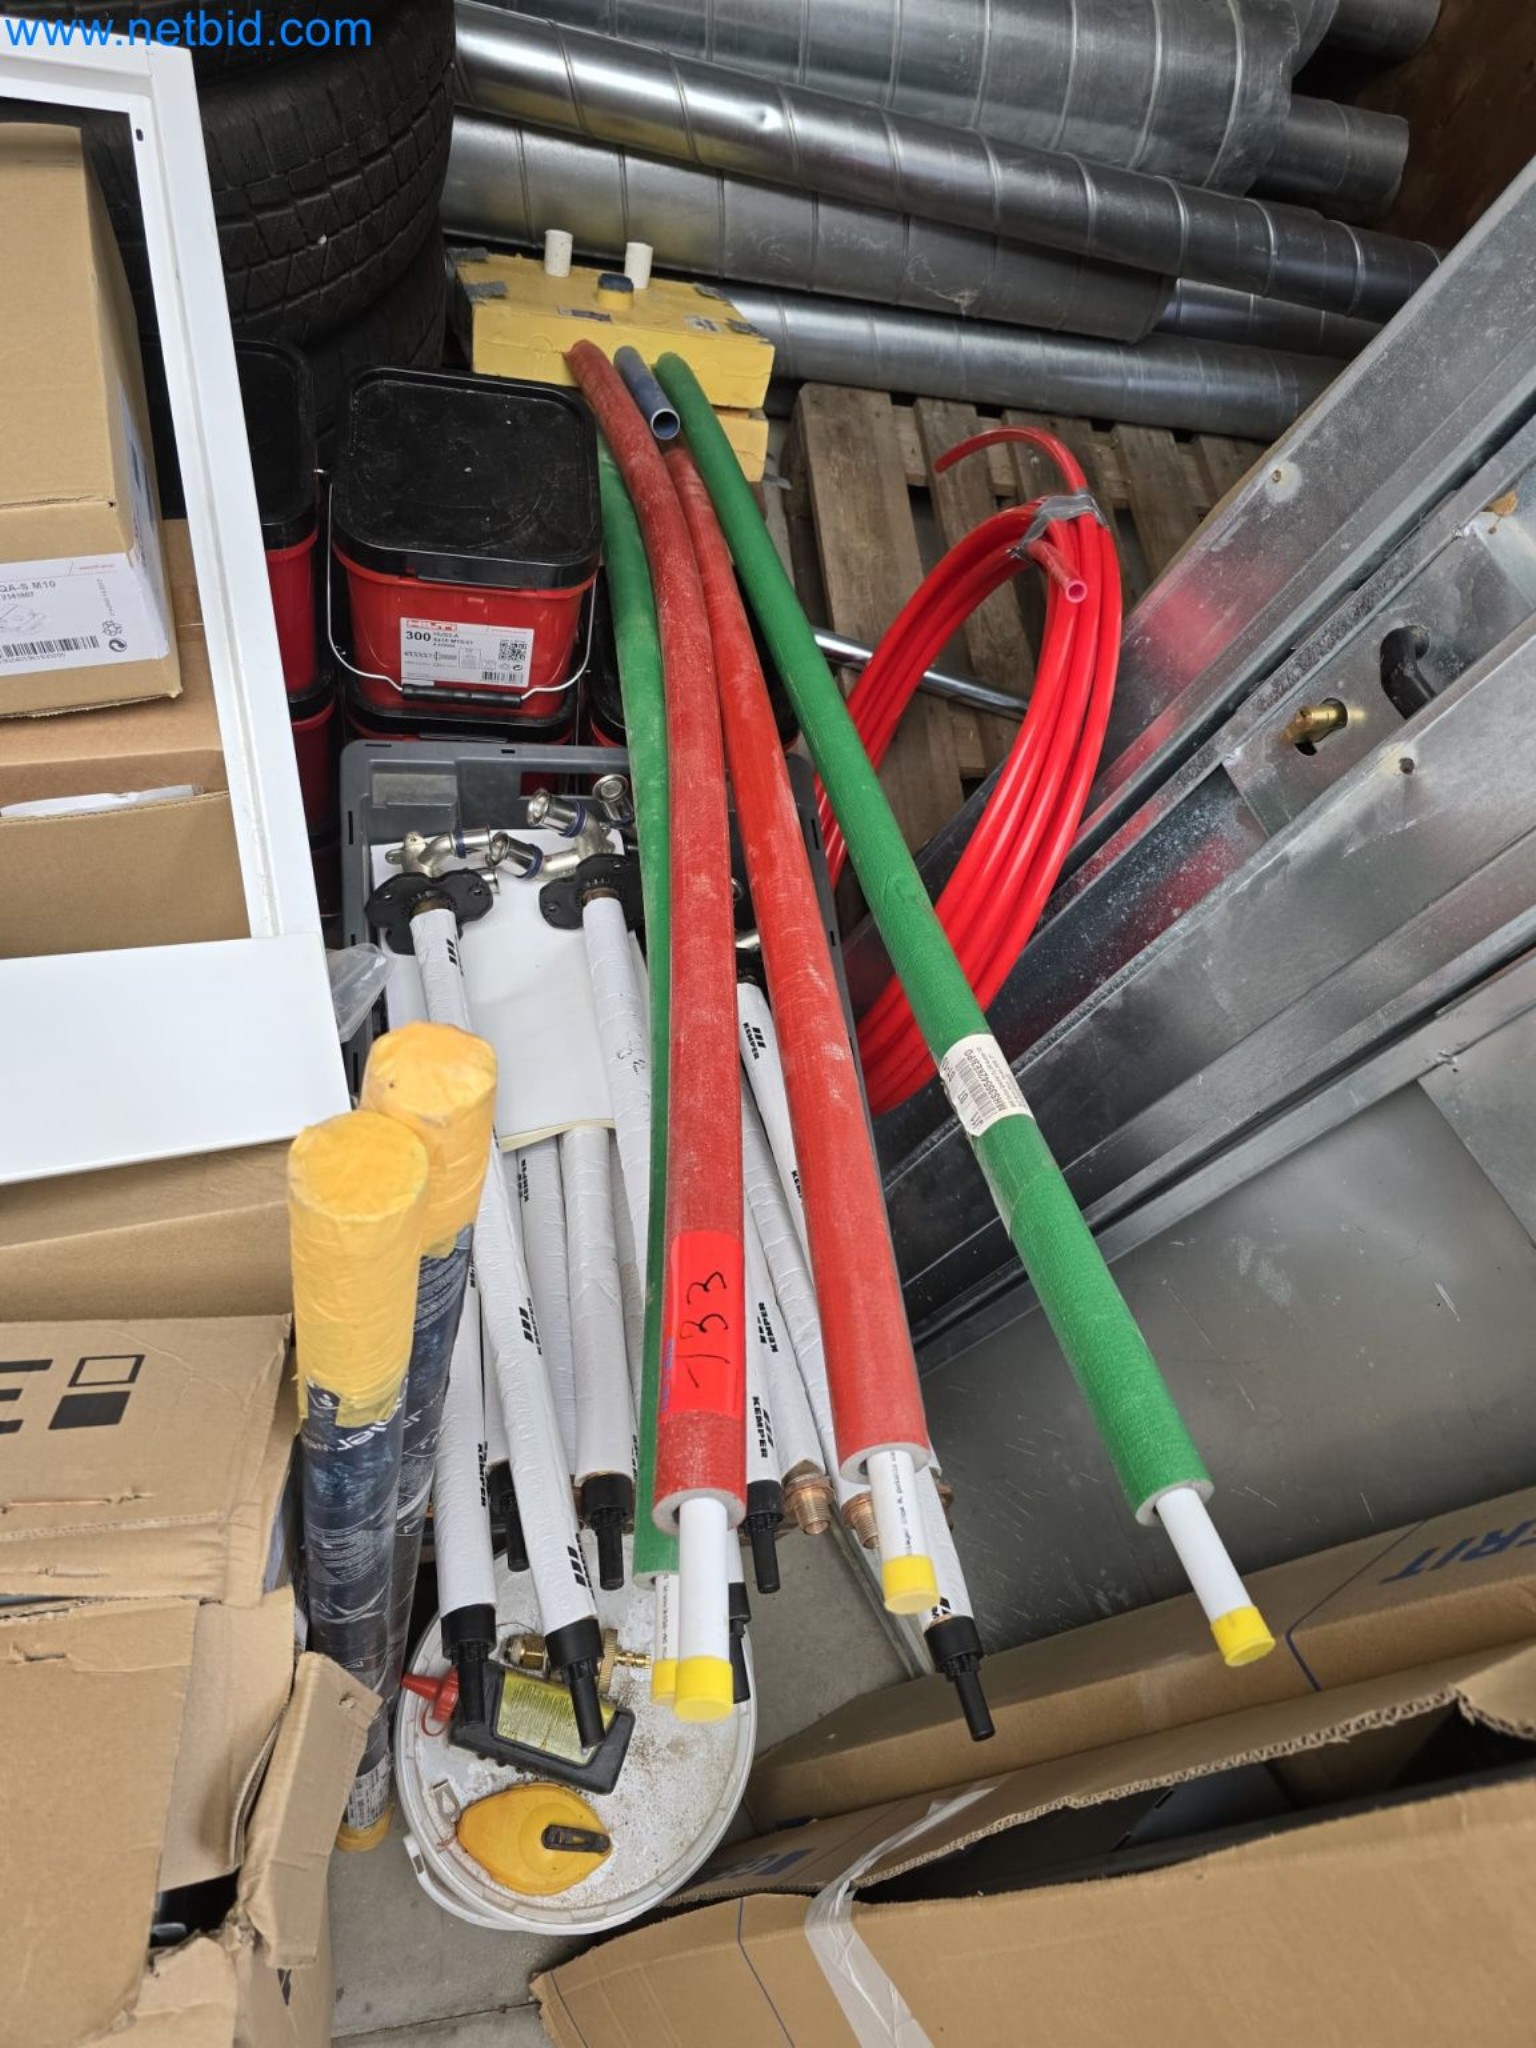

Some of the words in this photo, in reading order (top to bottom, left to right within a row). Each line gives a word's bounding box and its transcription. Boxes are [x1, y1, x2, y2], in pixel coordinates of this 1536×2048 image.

[32, 581, 56, 591] M10
[406, 631, 431, 642] 300
[743, 1022, 760, 1060] KEMPER
[758, 1302, 779, 1353] KEMPER
[752, 1396, 768, 1458] KEMPER
[1379, 1518, 1536, 1584] RIT
